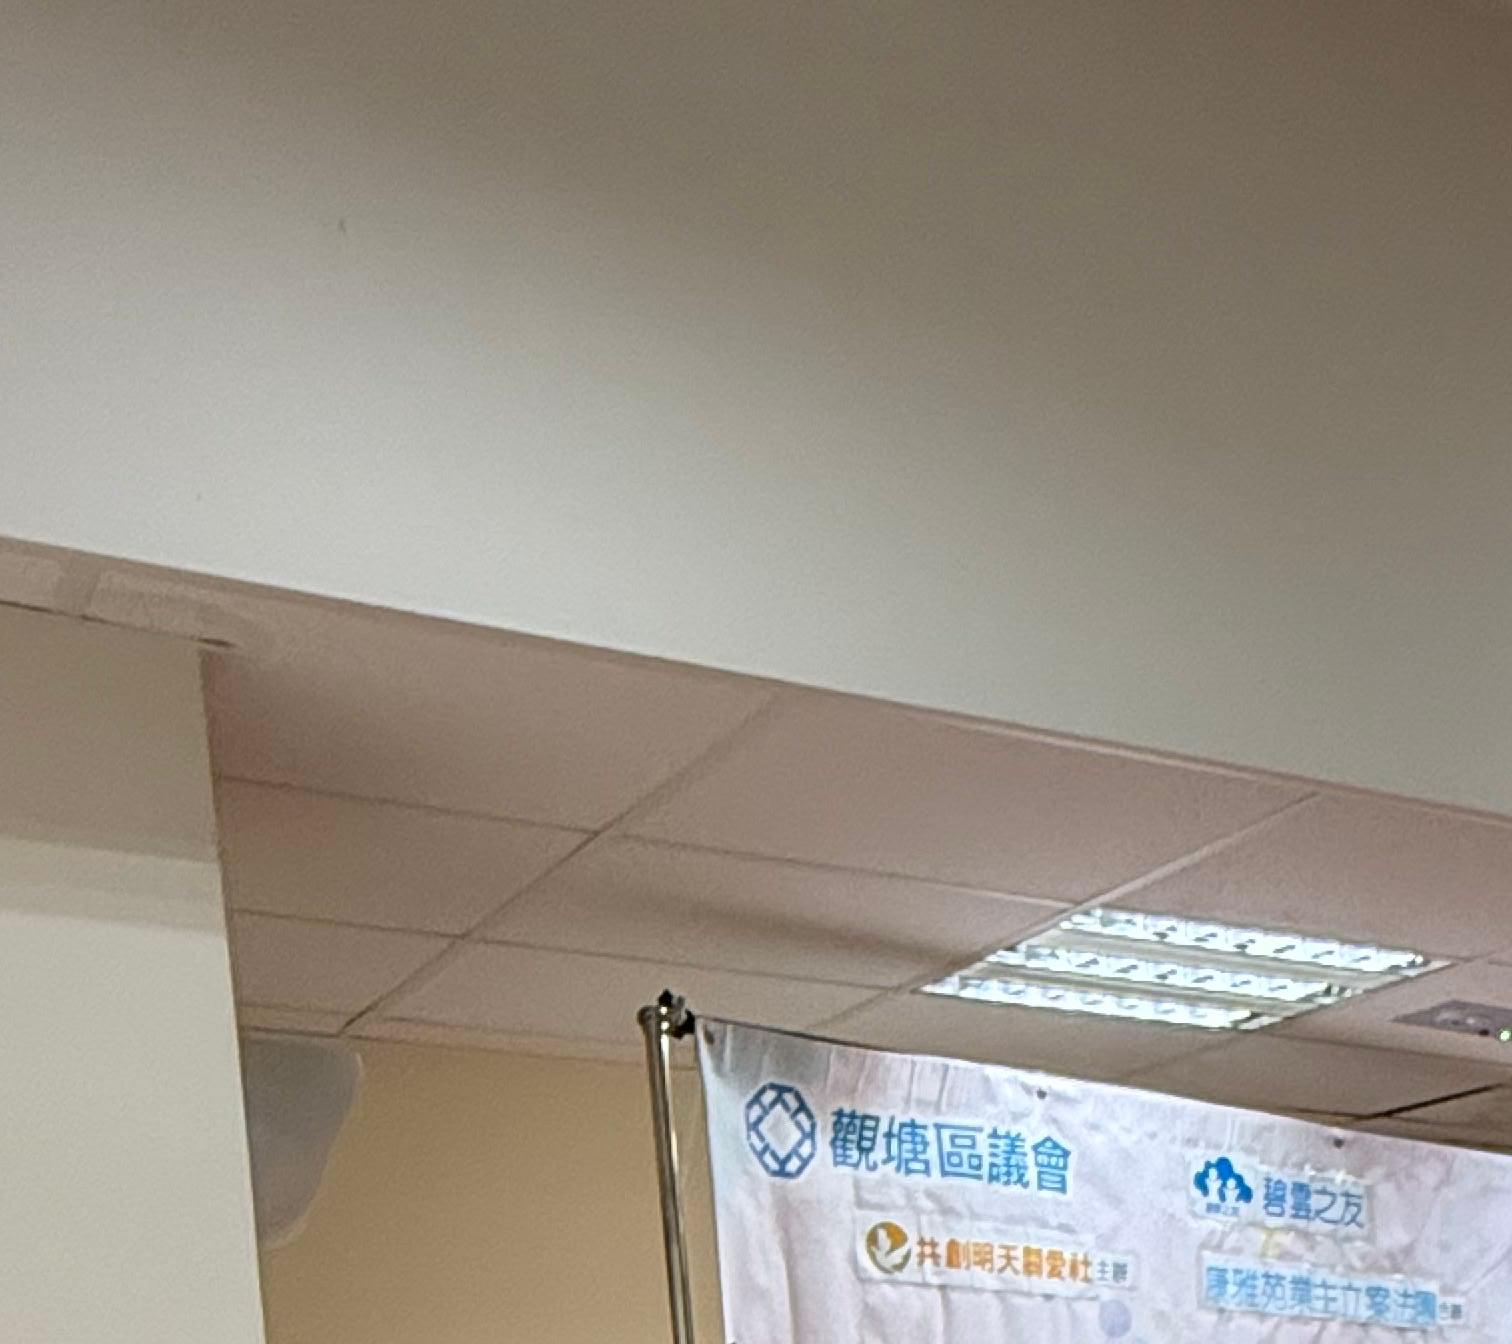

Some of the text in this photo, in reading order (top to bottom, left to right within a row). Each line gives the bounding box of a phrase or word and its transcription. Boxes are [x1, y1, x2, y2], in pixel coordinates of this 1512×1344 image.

[829, 1108, 1071, 1194] 觀塘區議會
[1263, 1177, 1365, 1228] 碧雲之友
[917, 1236, 1093, 1283] 共創明天關愛社
